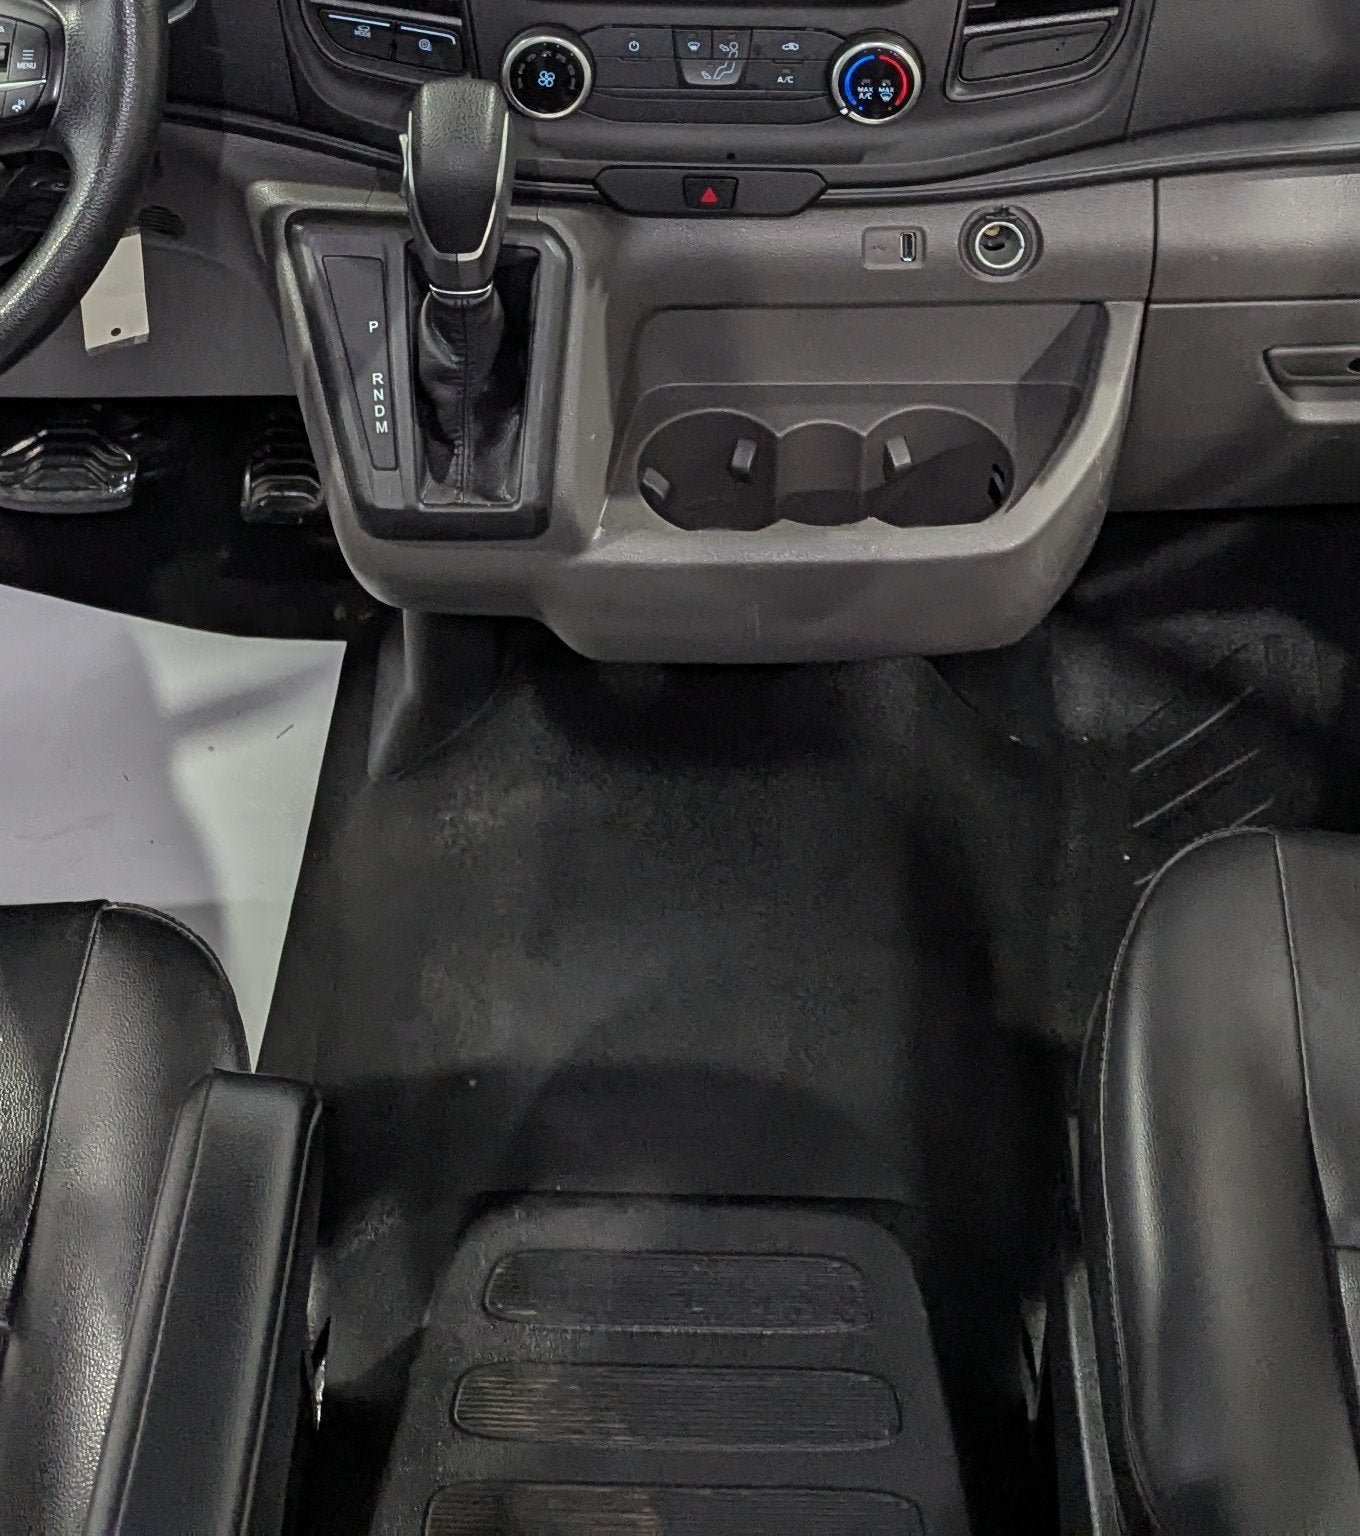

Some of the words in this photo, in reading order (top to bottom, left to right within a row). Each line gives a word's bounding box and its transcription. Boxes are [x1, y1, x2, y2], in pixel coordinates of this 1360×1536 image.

[16, 61, 37, 70] MENU
[776, 75, 794, 84] A/C
[878, 86, 895, 94] MAX
[858, 93, 873, 101] A/C
[368, 320, 379, 334] P
[372, 372, 385, 385] R
[373, 387, 385, 402] N
[374, 404, 386, 418] D
[375, 420, 389, 434] M
